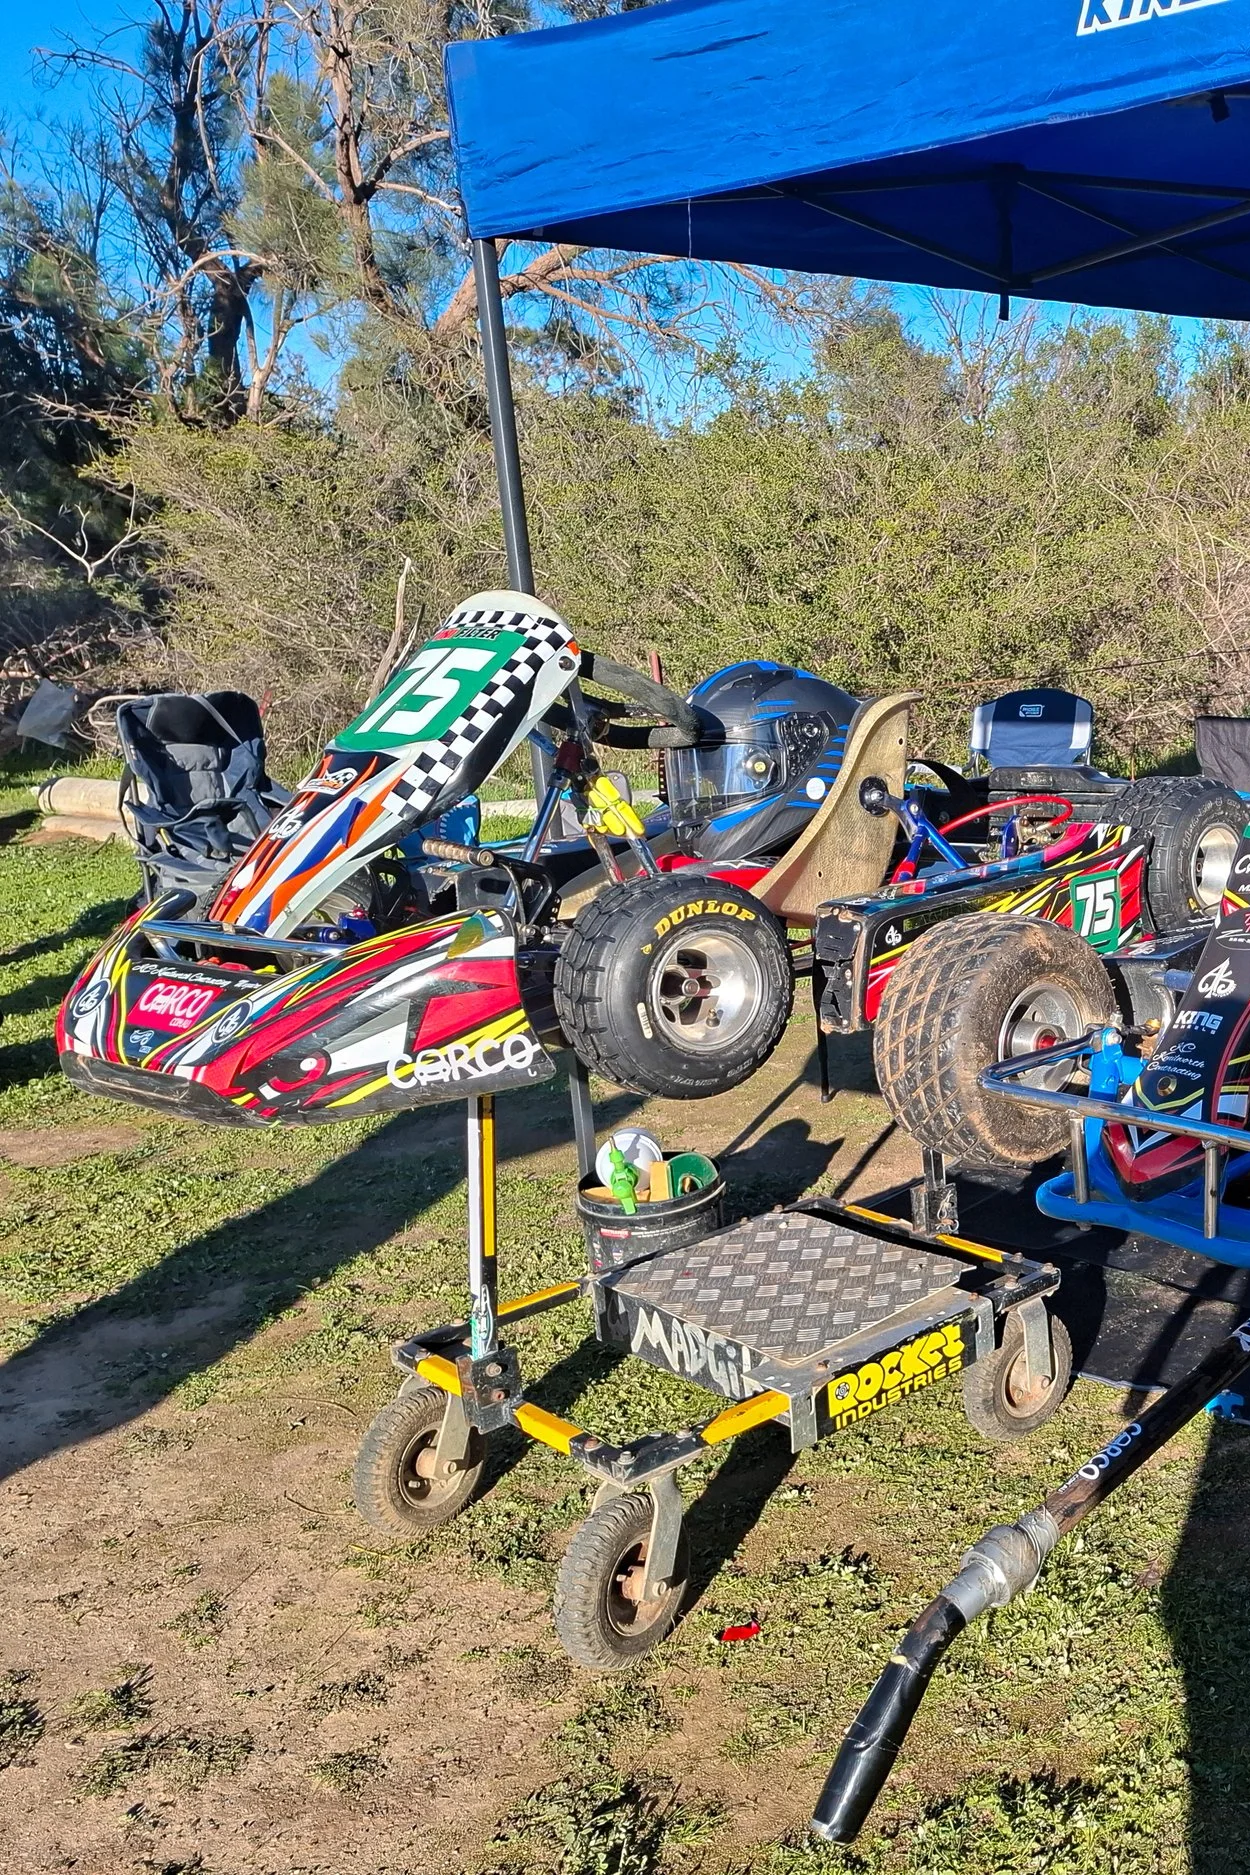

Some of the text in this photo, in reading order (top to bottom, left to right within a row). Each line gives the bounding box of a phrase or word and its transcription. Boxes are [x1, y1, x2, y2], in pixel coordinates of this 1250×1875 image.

[354, 648, 497, 735] 75
[654, 900, 756, 938] DUNLOP
[1076, 879, 1115, 937] 75
[139, 983, 214, 1019] CARCO
[1175, 1010, 1223, 1030] KING
[387, 1034, 542, 1089] CARCO
[1146, 1061, 1202, 1081] Contracting
[836, 1355, 962, 1430] INDUSTRIES
